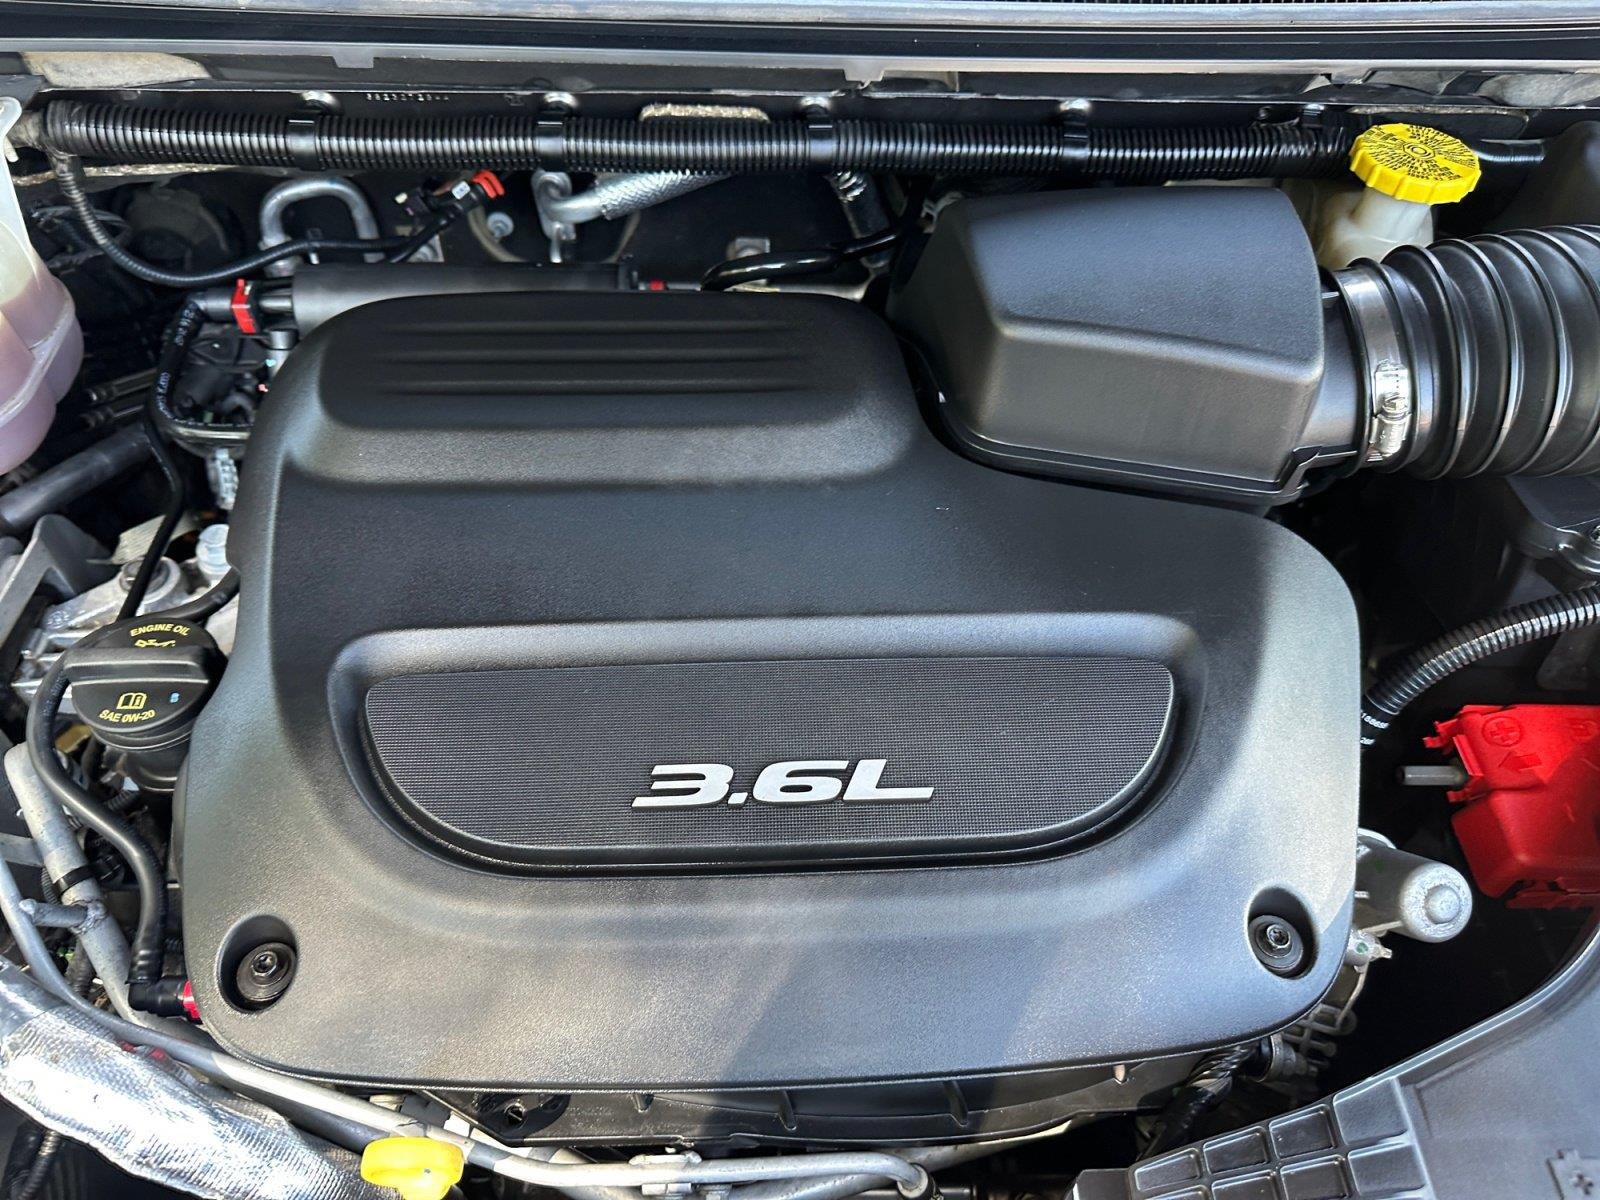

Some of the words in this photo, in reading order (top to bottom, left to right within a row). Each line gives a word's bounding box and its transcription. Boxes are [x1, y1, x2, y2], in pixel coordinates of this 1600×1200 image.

[130, 623, 174, 637] ENGINE
[174, 624, 191, 637] OIL
[99, 709, 121, 723] SAE
[121, 709, 156, 723] 0W-20
[632, 757, 935, 809] 3.6L
